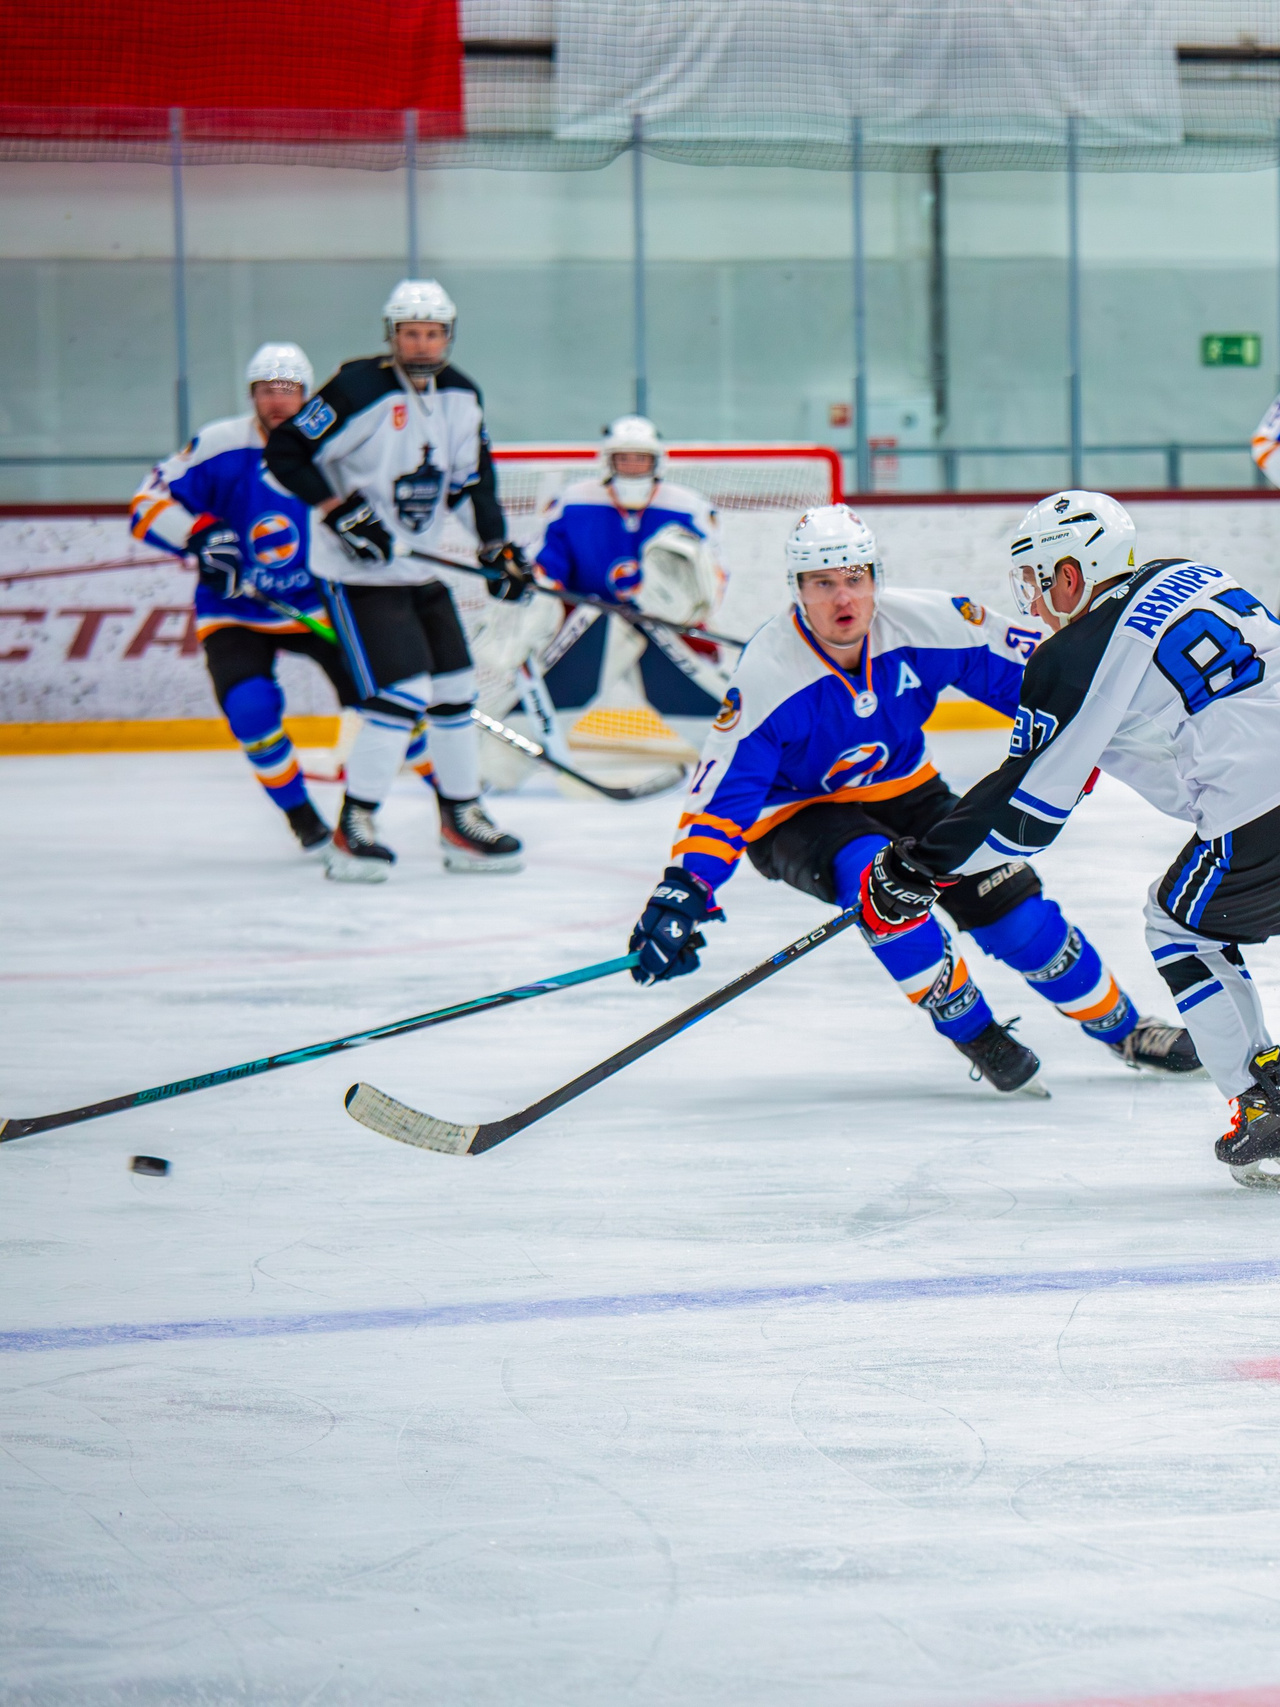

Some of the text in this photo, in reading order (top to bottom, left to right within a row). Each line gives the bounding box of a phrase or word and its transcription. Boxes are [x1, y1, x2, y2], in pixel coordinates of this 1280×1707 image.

[896, 659, 922, 697] A
[1009, 704, 1060, 759] 87
[874, 850, 936, 908] BAUER
[977, 861, 1029, 898] BAUE
